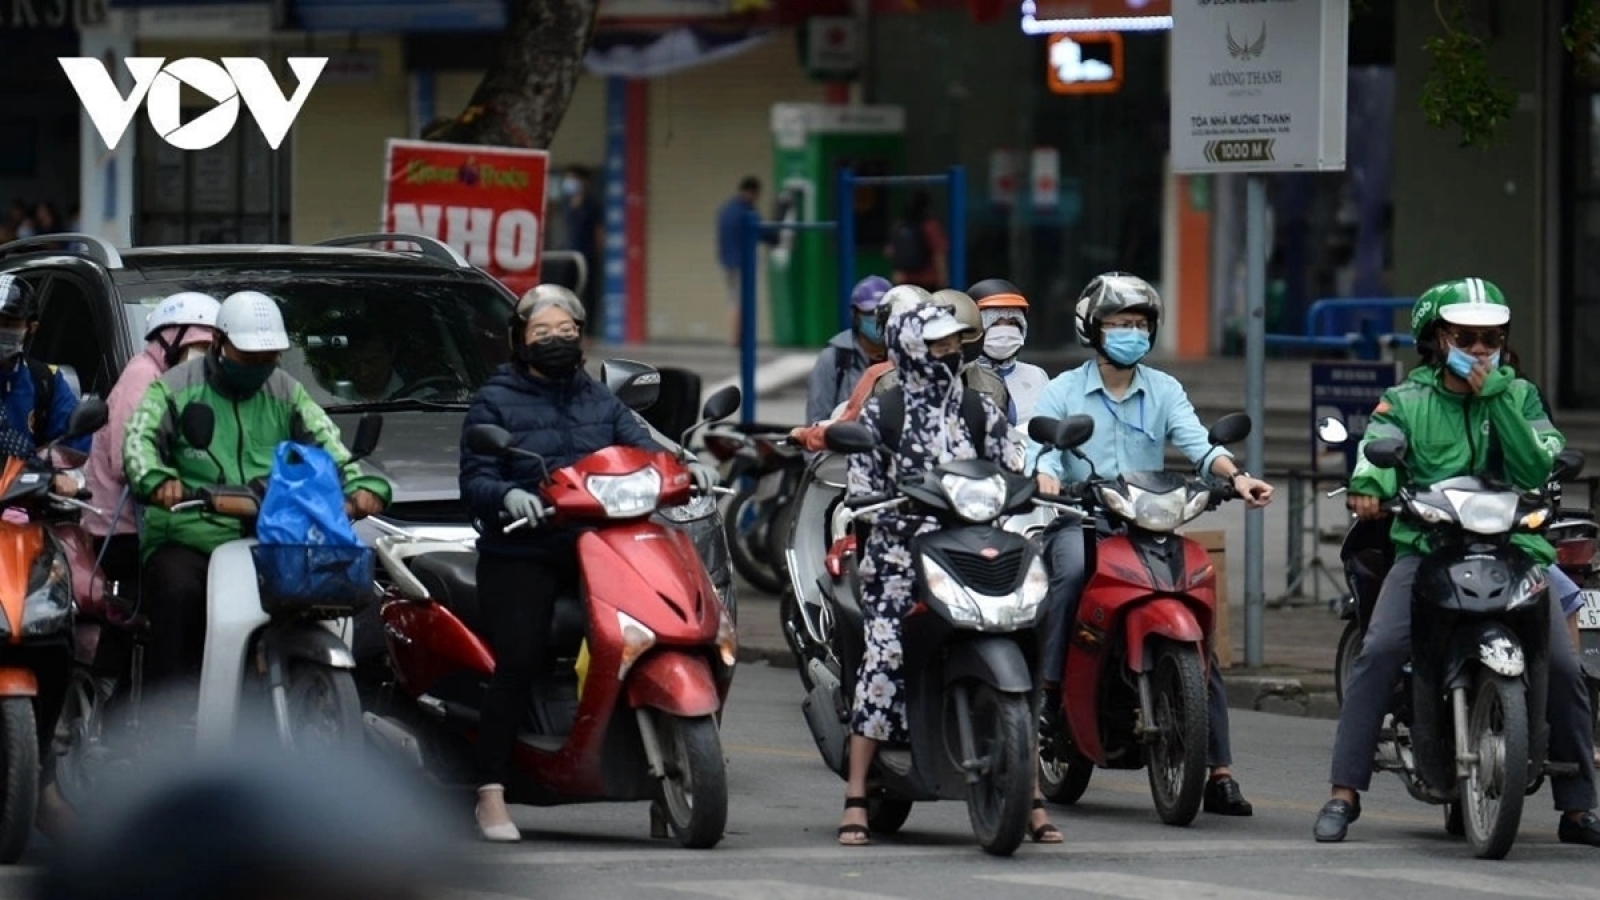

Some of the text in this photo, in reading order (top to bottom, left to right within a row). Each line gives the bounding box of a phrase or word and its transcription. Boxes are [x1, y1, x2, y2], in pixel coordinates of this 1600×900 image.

[1246, 70, 1282, 85] THANH
[1221, 142, 1263, 159] 1000 M
